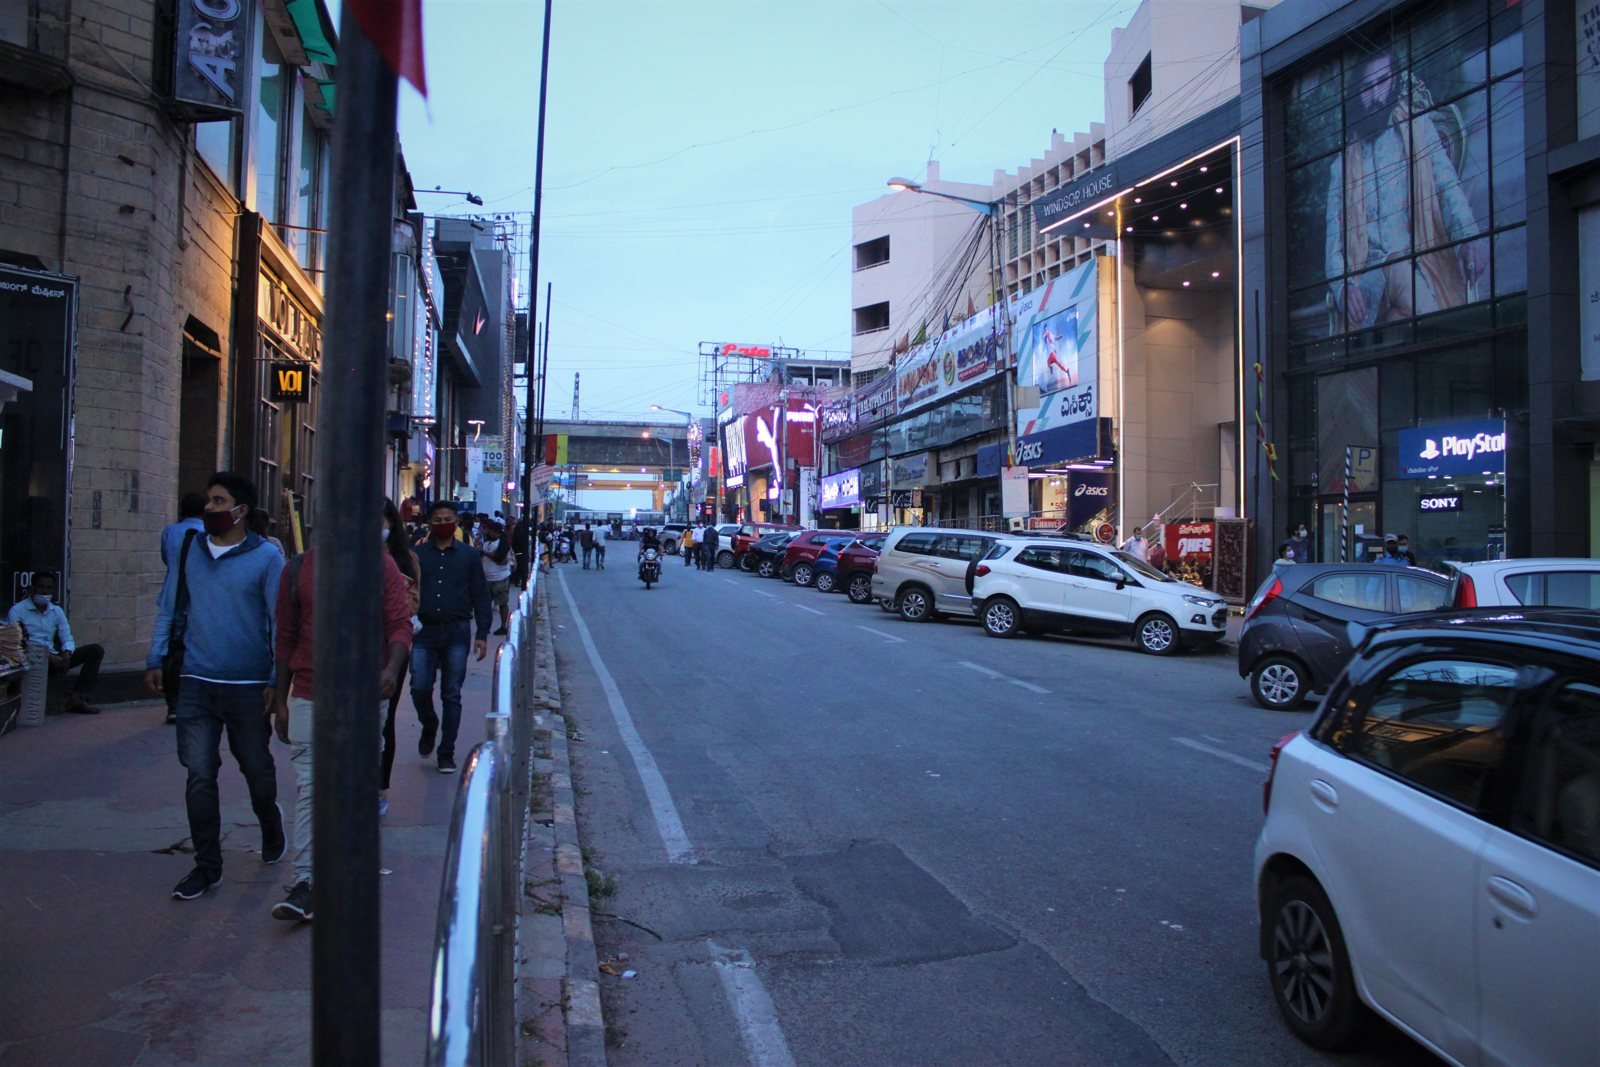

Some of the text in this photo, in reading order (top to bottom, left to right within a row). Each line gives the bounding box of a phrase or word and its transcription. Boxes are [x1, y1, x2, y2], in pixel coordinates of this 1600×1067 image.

[1044, 174, 1112, 216] WINDSOR HOUSE
[278, 370, 303, 392] VOI
[1023, 440, 1043, 461] asics
[1358, 448, 1371, 466] P
[1085, 486, 1109, 496] asics
[1420, 497, 1458, 509] SONY
